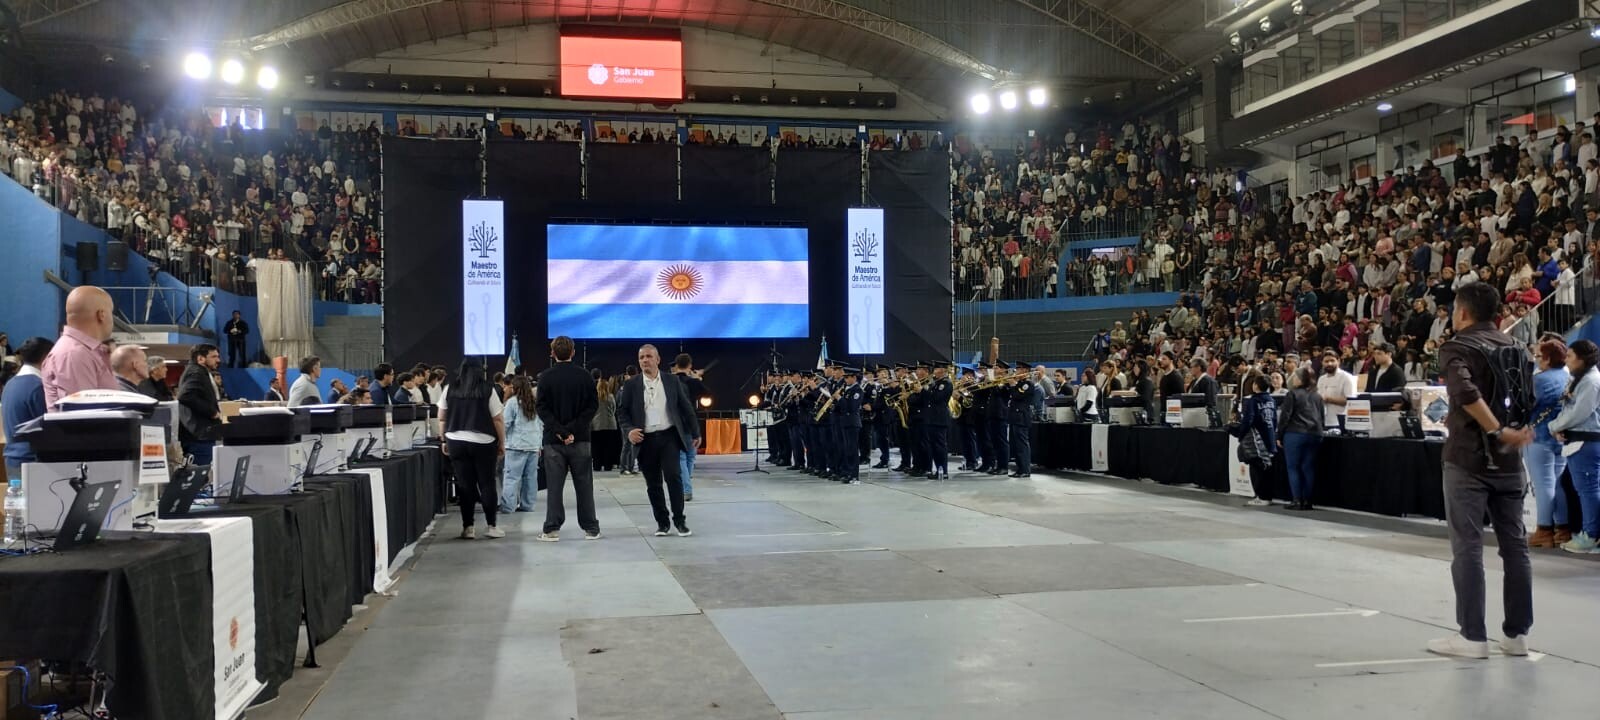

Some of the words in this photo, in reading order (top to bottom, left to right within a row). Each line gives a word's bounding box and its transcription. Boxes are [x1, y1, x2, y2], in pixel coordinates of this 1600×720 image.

[613, 67, 631, 76] San
[633, 68, 655, 77] Juan
[471, 261, 498, 270] Maestro
[854, 265, 878, 274] Maestro
[477, 270, 501, 279] América
[852, 274, 859, 282] de
[860, 274, 881, 282] América
[223, 664, 233, 682] San
[233, 652, 245, 672] Juan
